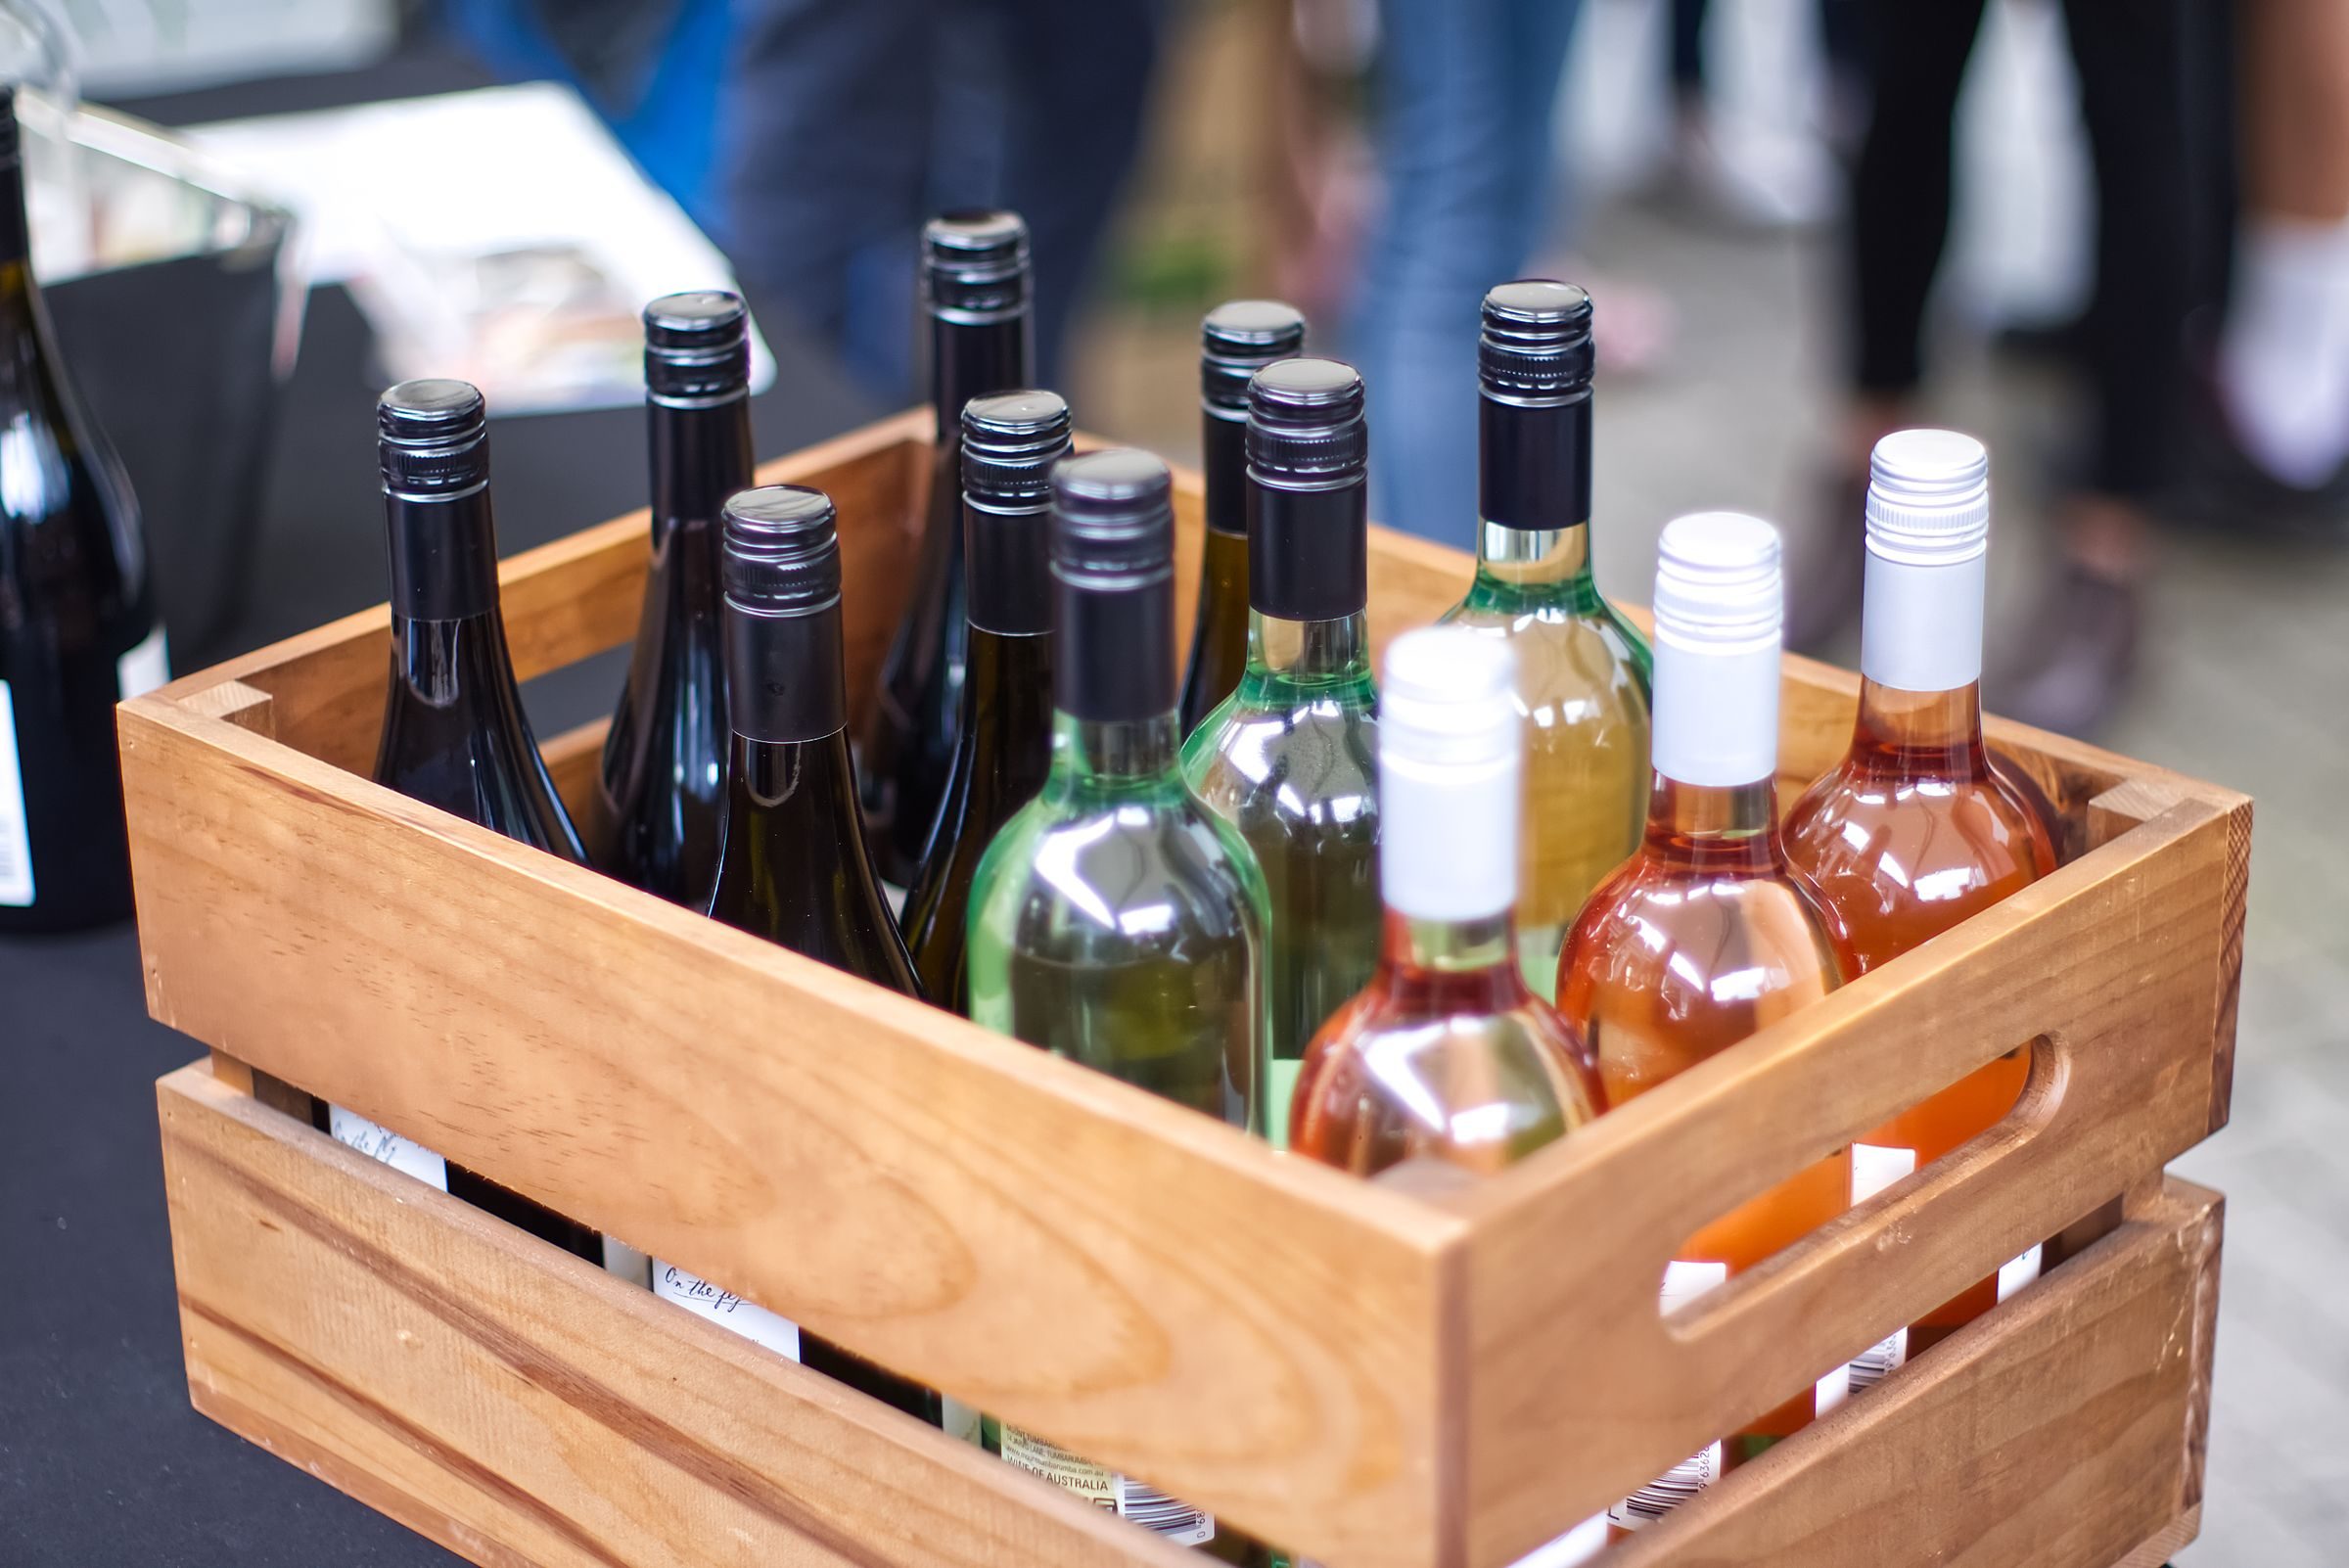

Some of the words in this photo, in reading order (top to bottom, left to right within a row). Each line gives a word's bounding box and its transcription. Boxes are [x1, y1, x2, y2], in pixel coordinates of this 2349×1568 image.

[666, 1267, 684, 1289] On
[688, 1279, 714, 1297] the
[1046, 1472, 1109, 1491] AUSTRALIA
